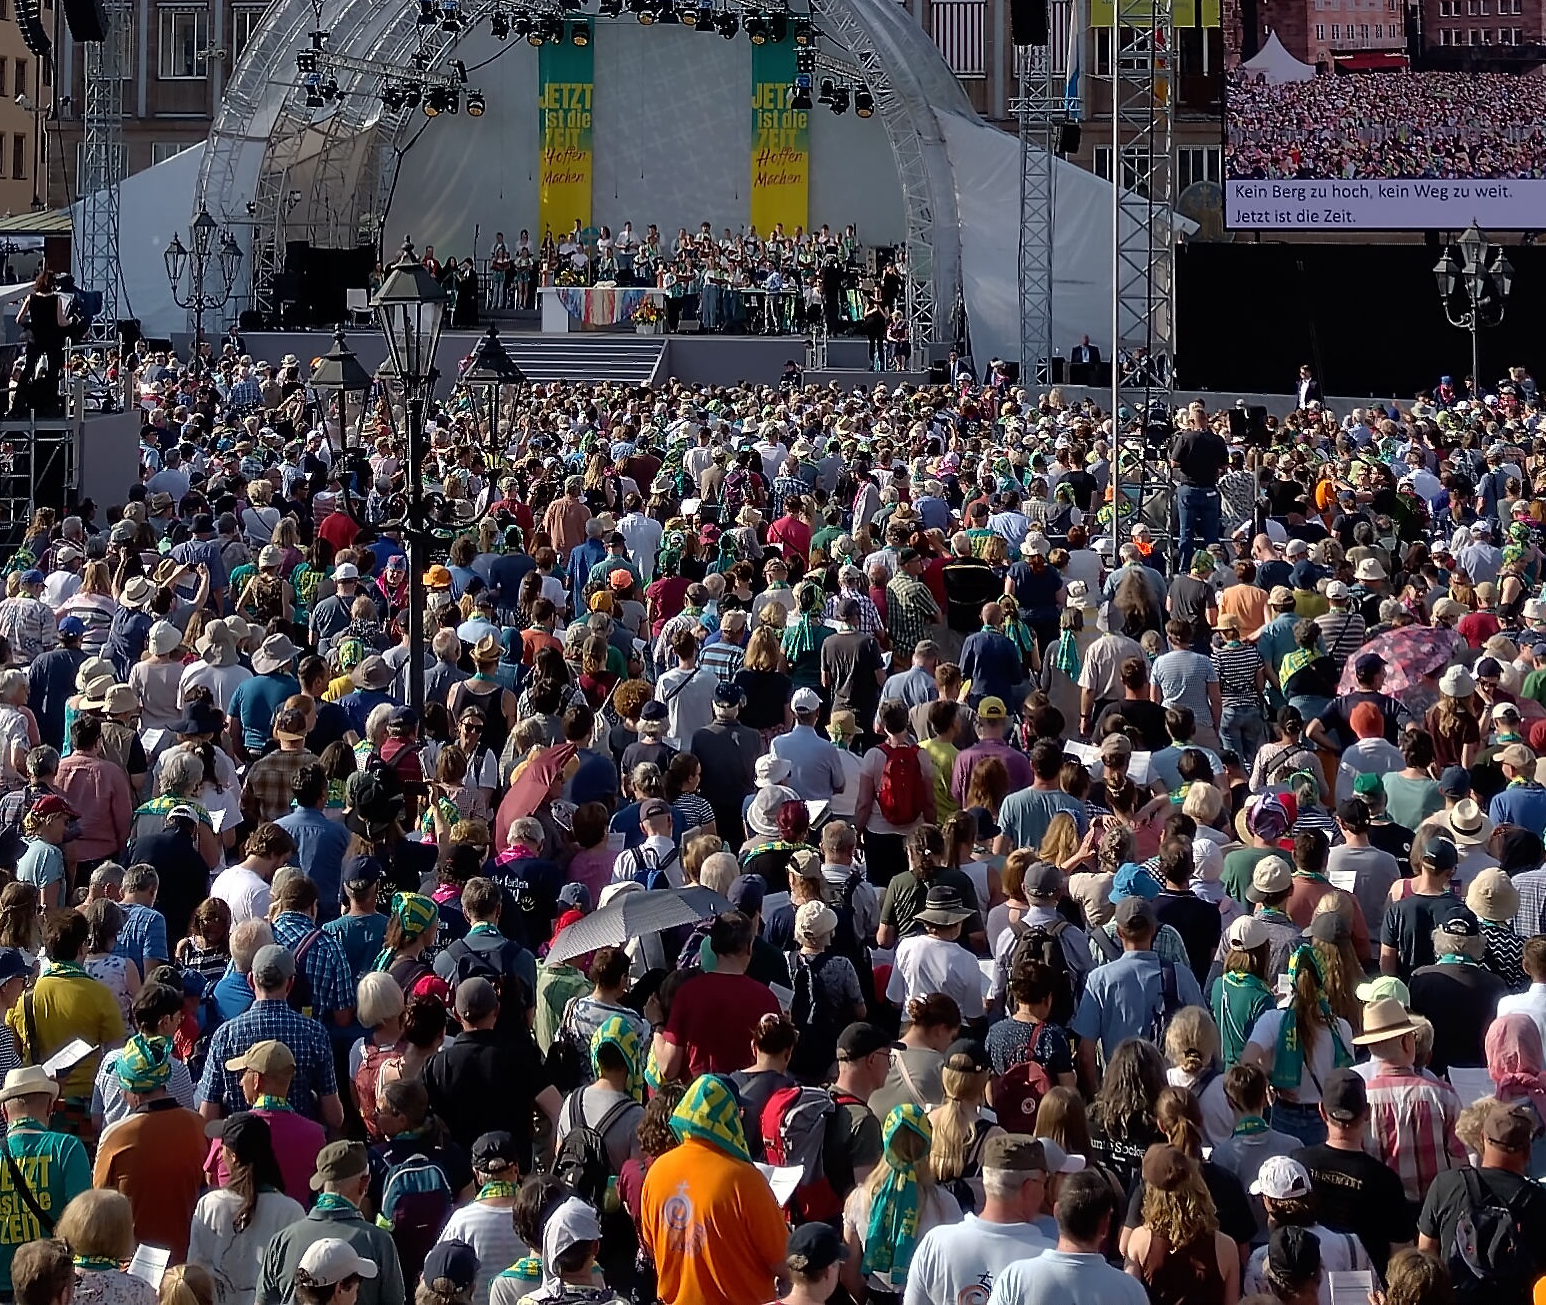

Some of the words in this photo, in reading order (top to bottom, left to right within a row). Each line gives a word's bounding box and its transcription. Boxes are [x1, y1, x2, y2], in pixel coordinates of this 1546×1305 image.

[538, 82, 594, 109] JETZT
[751, 82, 793, 109] JET
[567, 109, 591, 128] die
[758, 109, 779, 128] ist
[782, 109, 807, 128] die
[757, 128, 798, 152] ZEIT
[1235, 184, 1268, 199] Kein
[1272, 185, 1306, 201] Berg
[1310, 187, 1327, 199] zu
[1332, 184, 1373, 200] hoch,
[1378, 184, 1409, 199] kein
[1414, 185, 1449, 201] Weg
[1453, 187, 1470, 199] zu
[1474, 185, 1513, 199] weit.
[1235, 209, 1271, 224] Jetzt
[1274, 209, 1292, 224] ist
[1296, 208, 1320, 223] die
[1324, 209, 1357, 224] Zeit.
